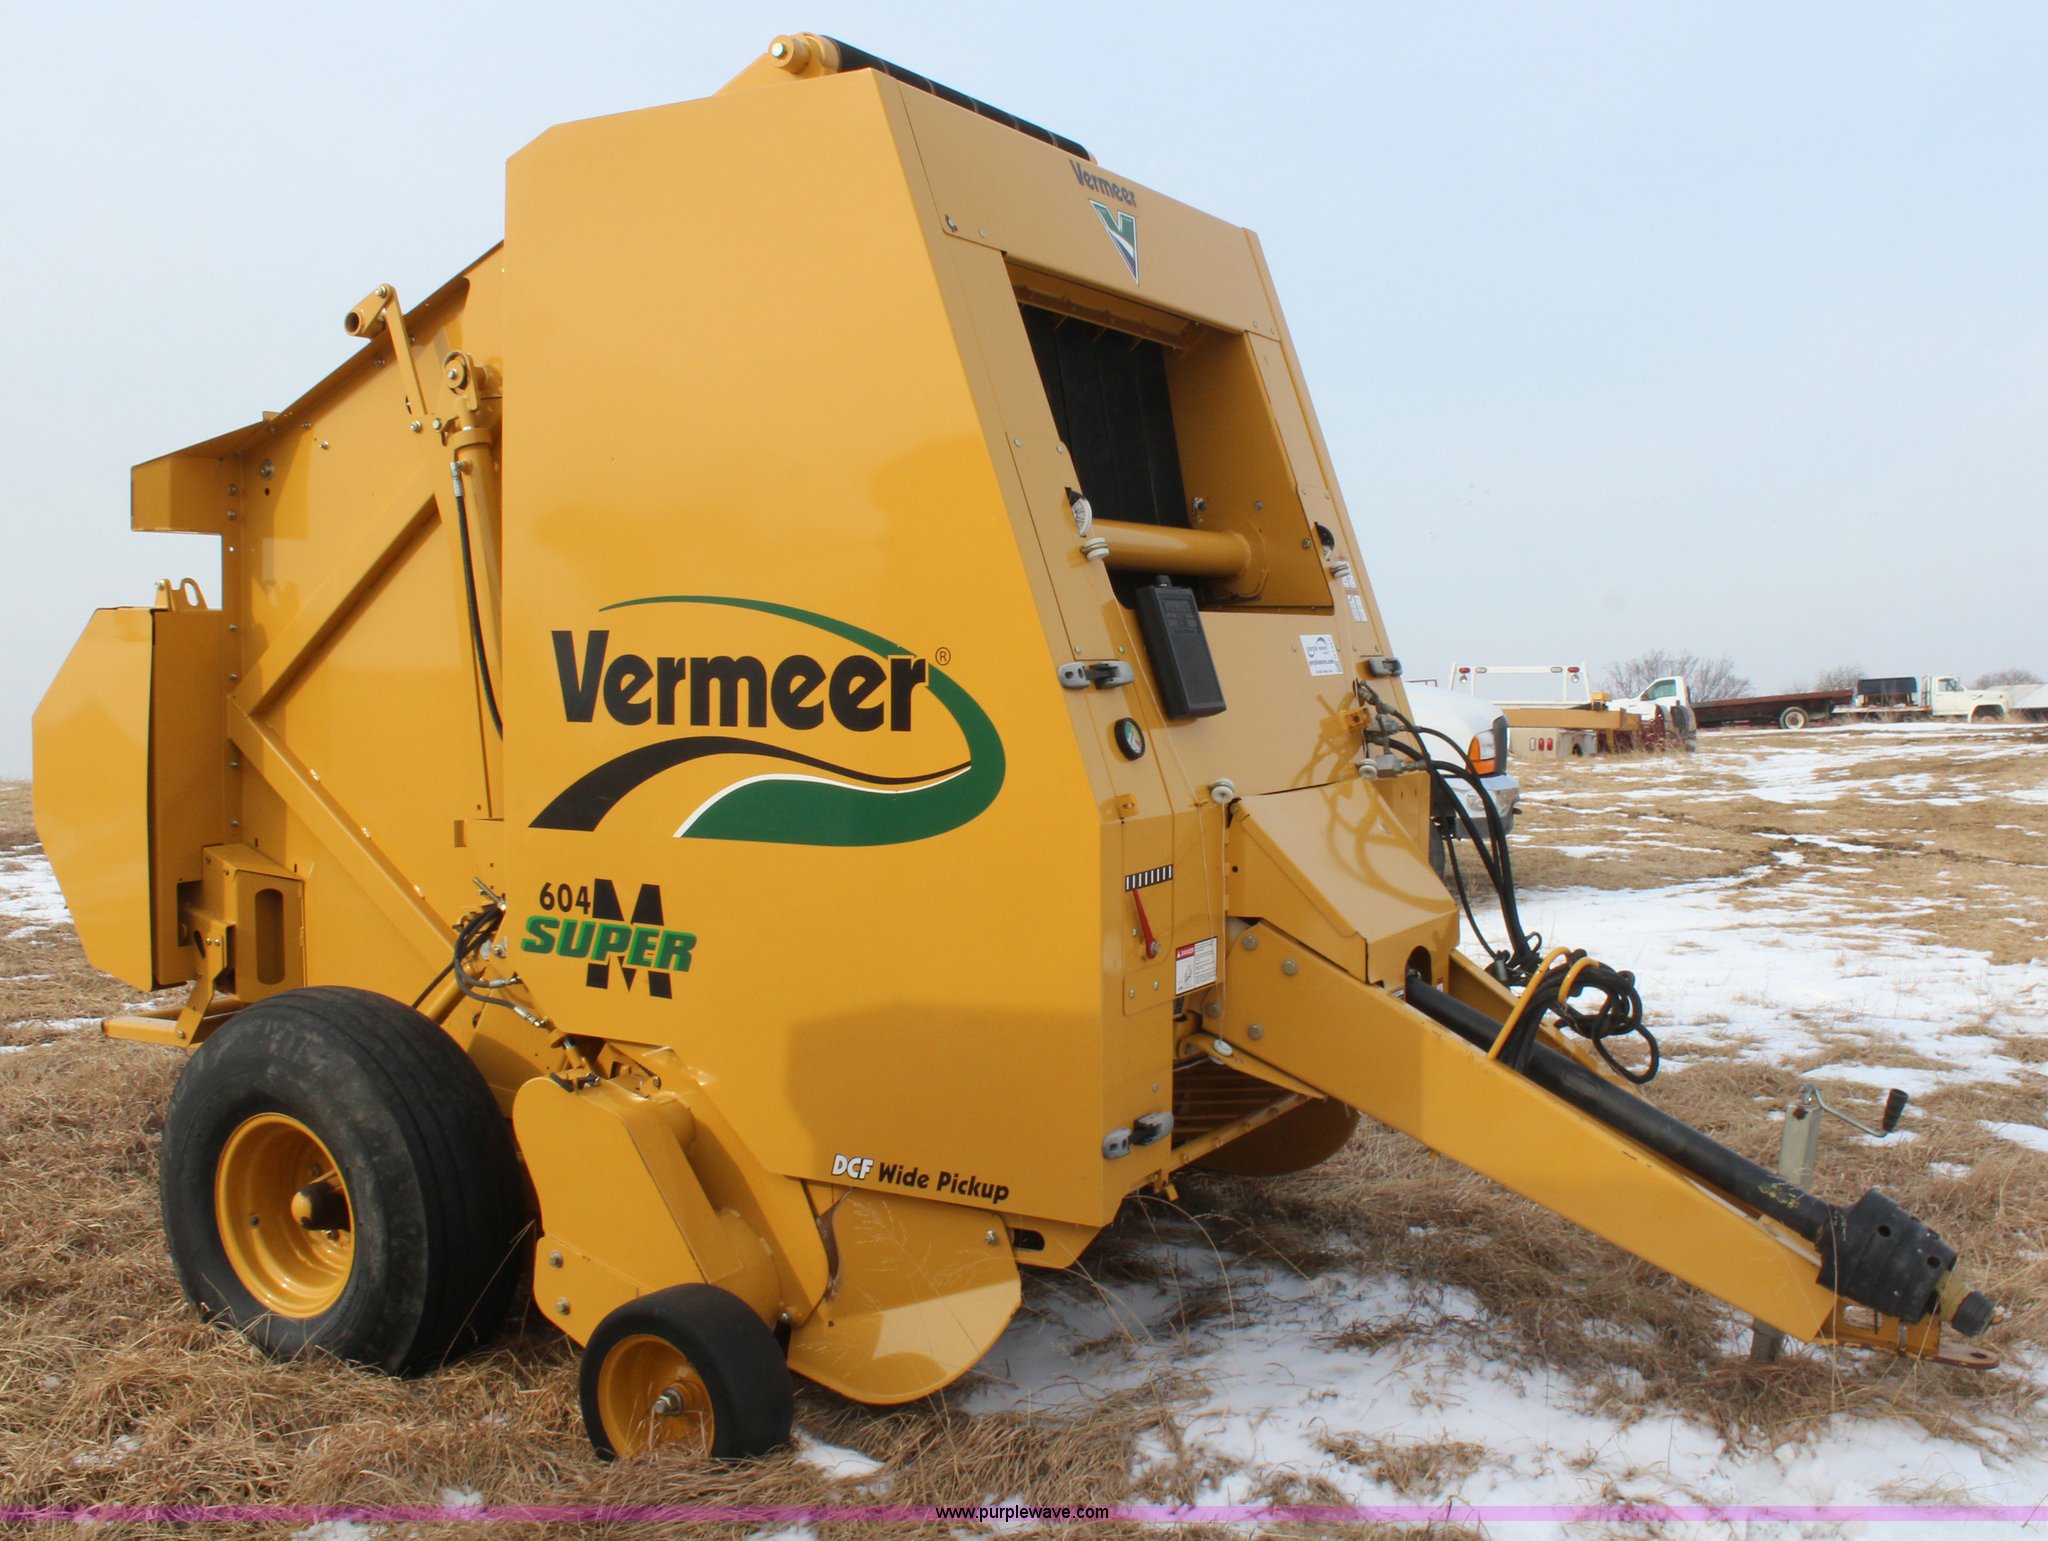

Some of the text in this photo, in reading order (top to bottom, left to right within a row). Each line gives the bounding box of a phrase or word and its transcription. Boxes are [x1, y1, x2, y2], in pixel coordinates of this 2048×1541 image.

[1069, 159, 1137, 208] Vermeer
[551, 630, 926, 732] Vermeer
[539, 881, 591, 915] 604
[520, 915, 697, 973] SUPER
[831, 1154, 1010, 1204] DCF Wide Pickup
